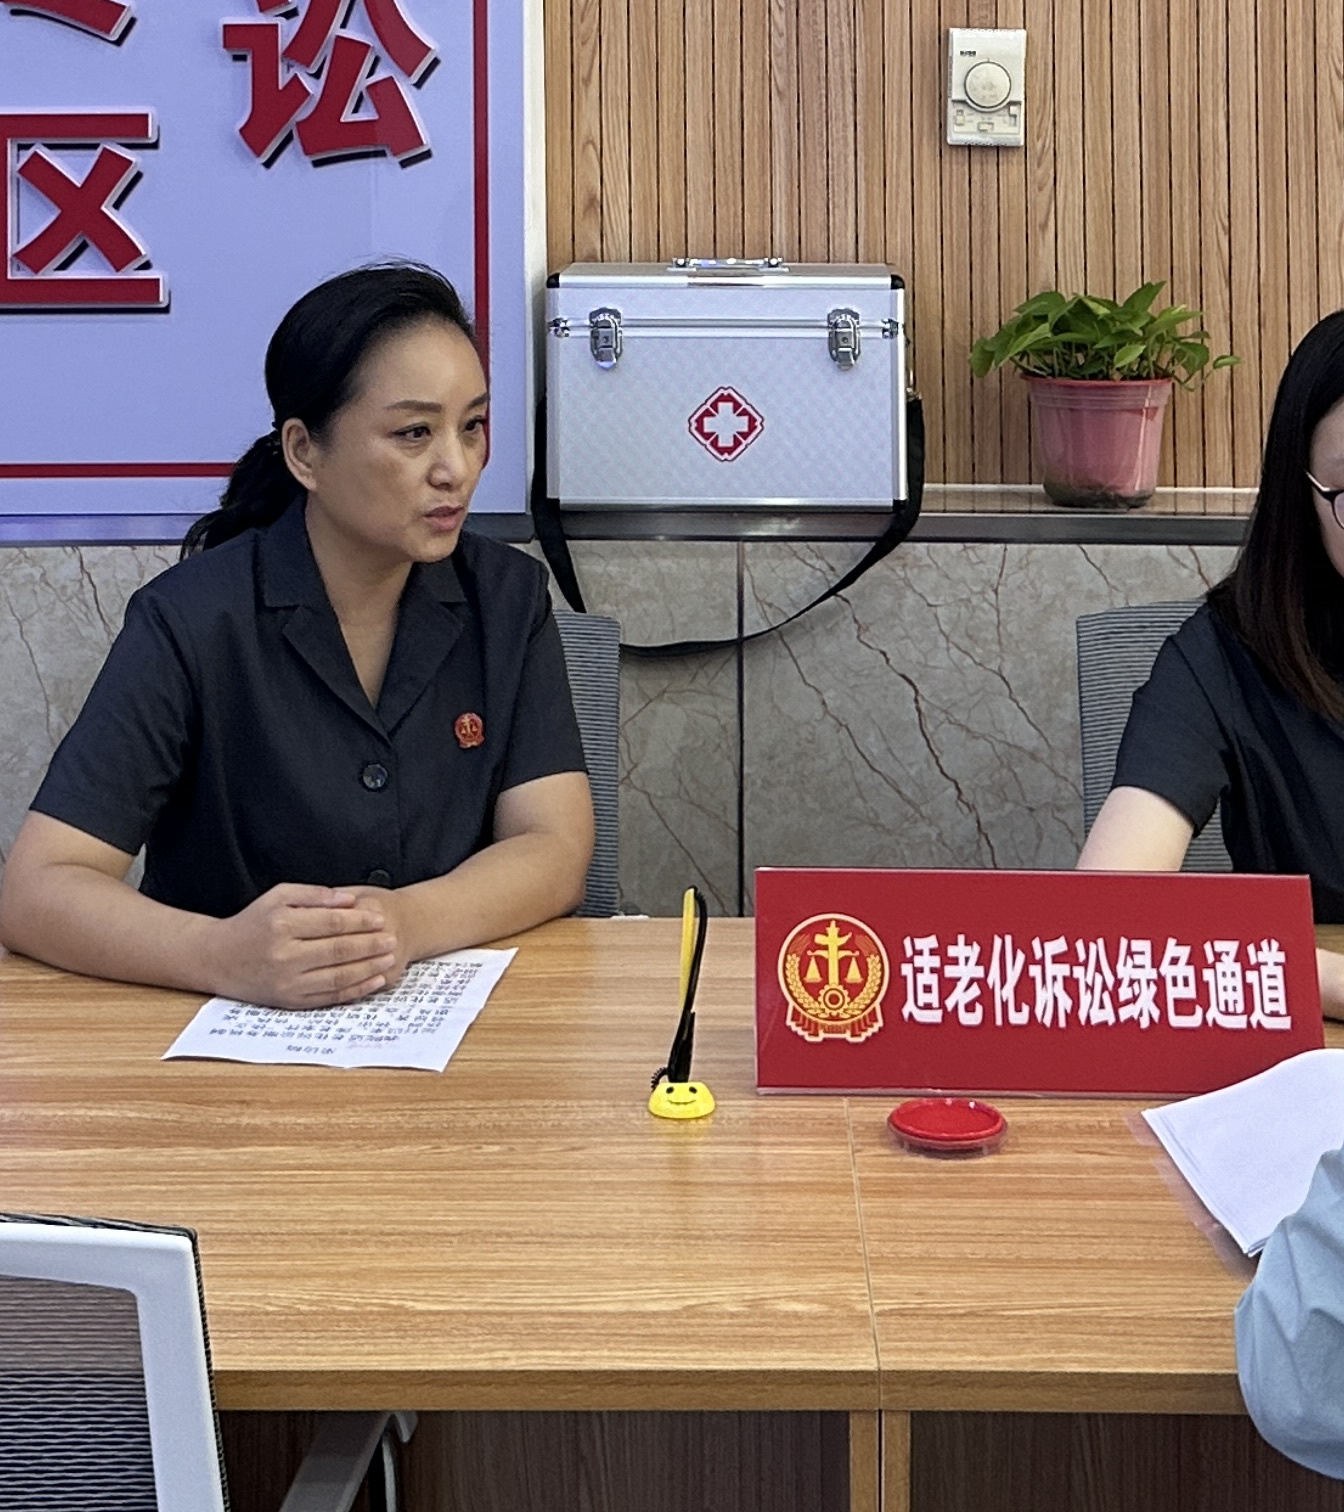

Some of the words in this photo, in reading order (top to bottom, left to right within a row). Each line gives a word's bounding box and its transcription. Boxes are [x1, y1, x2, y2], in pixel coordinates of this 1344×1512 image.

[900, 933, 1292, 1031] 适老化诉讼绿色通道
